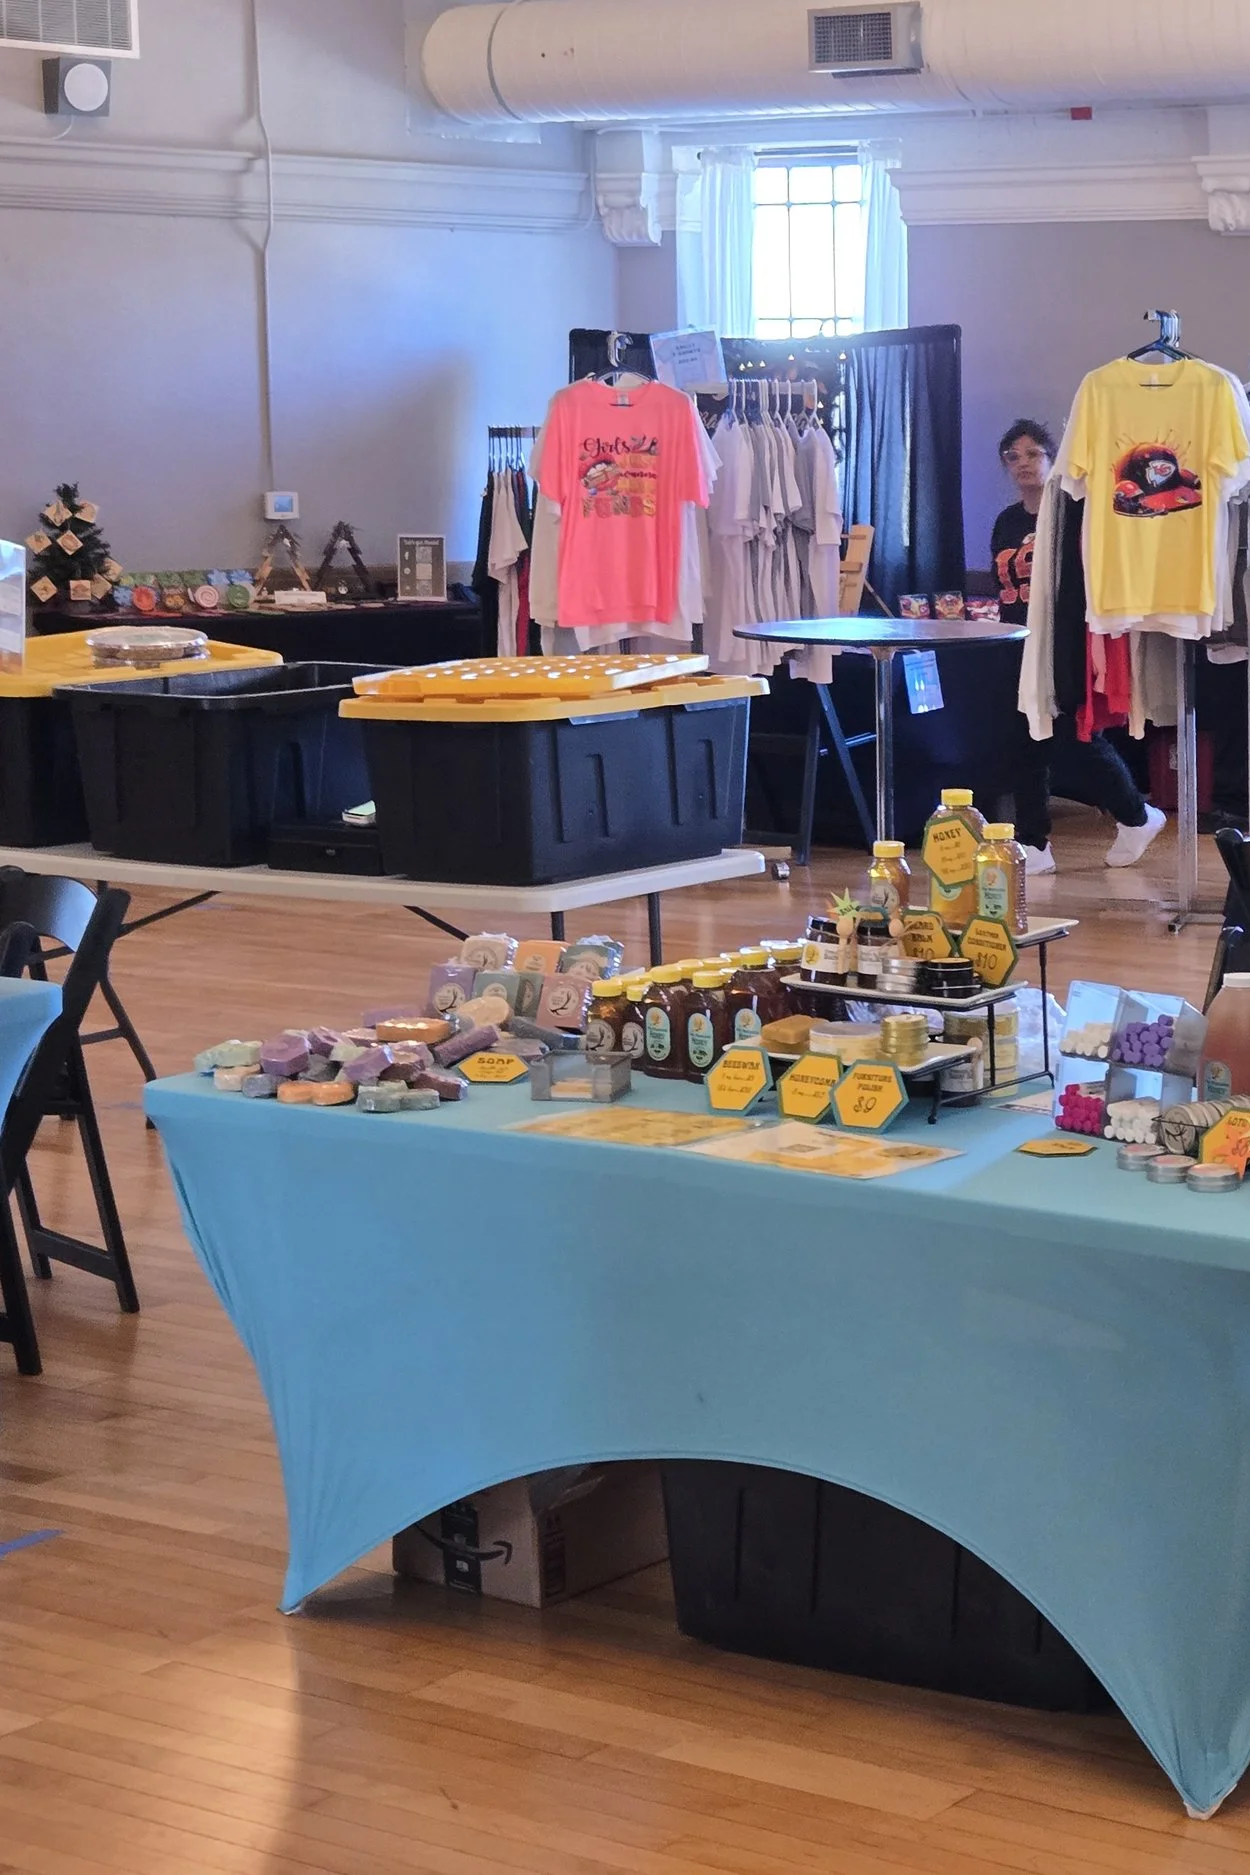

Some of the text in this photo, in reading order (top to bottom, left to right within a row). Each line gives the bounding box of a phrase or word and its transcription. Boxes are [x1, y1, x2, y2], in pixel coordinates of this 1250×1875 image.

[584, 437, 631, 458] Girls
[933, 828, 961, 843] HONEY
[975, 952, 998, 970] $10
[477, 1057, 515, 1065] SOAP
[852, 1072, 892, 1083] FURNITURE
